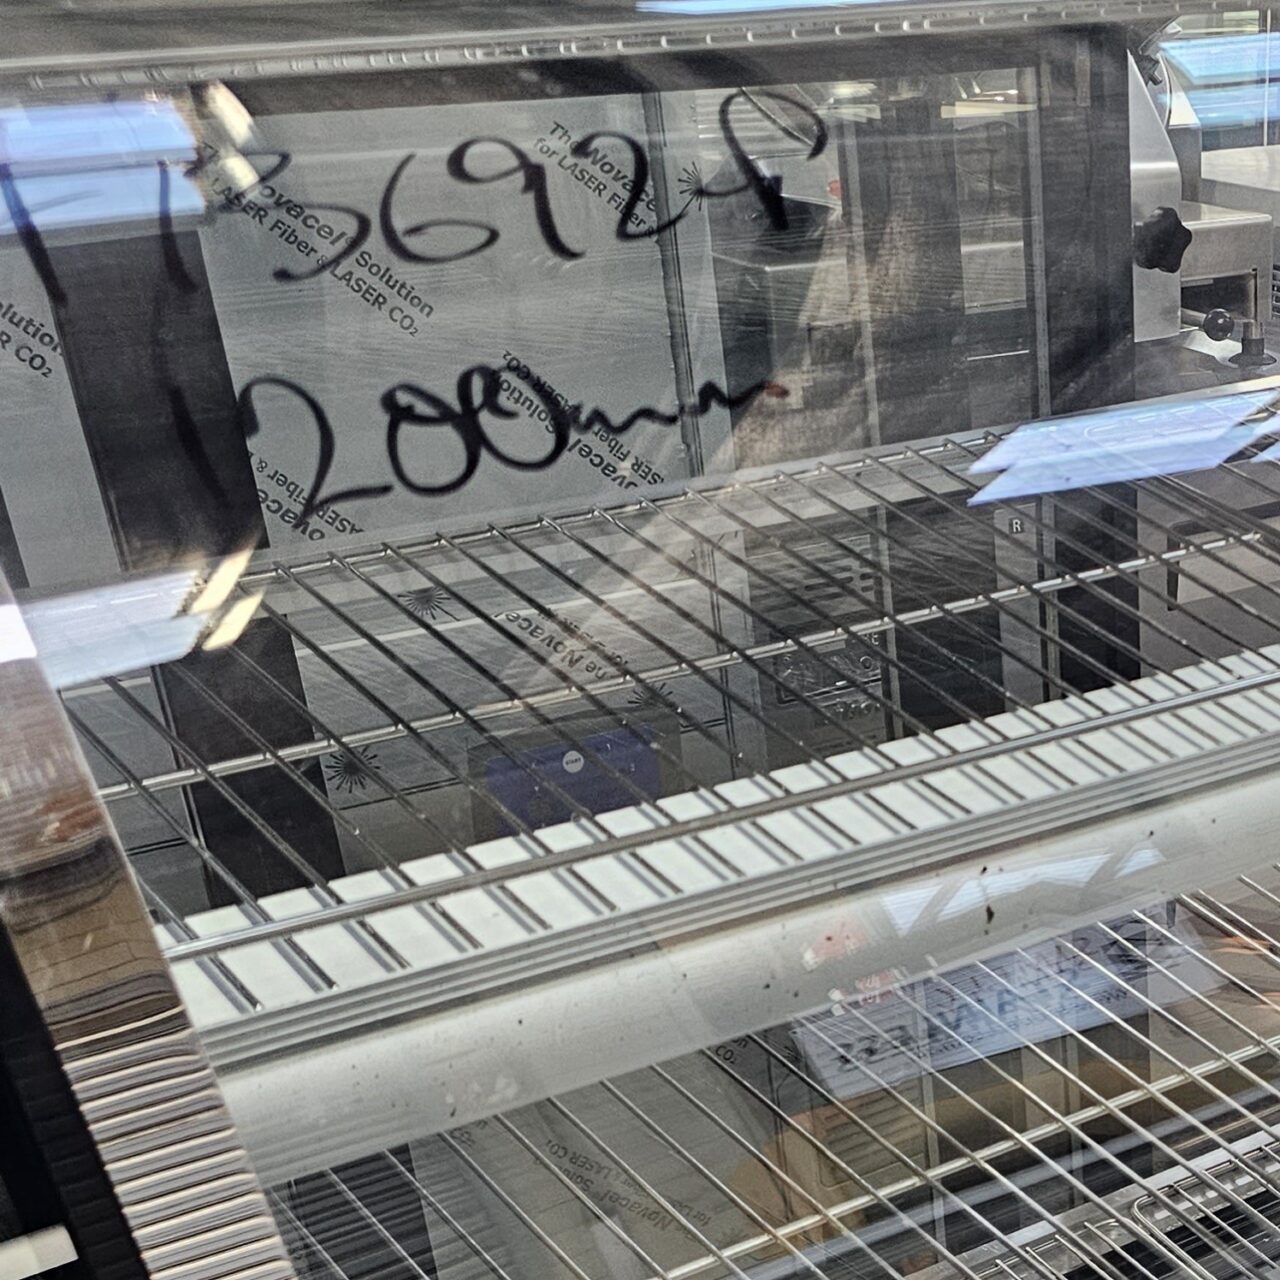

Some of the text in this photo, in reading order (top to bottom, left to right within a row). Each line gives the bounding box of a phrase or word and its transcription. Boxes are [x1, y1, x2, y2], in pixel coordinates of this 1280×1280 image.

[533, 137, 559, 159] for
[558, 155, 607, 198] LASER
[258, 183, 435, 320] ovacel Solution
[269, 219, 318, 258] Fiber
[329, 262, 387, 312] LASER
[499, 374, 558, 435] Solutio
[256, 456, 269, 473] &
[592, 427, 631, 462] Fiber
[629, 455, 665, 486] SER
[1012, 519, 1022, 533] R
[600, 1189, 673, 1232] Novacel
